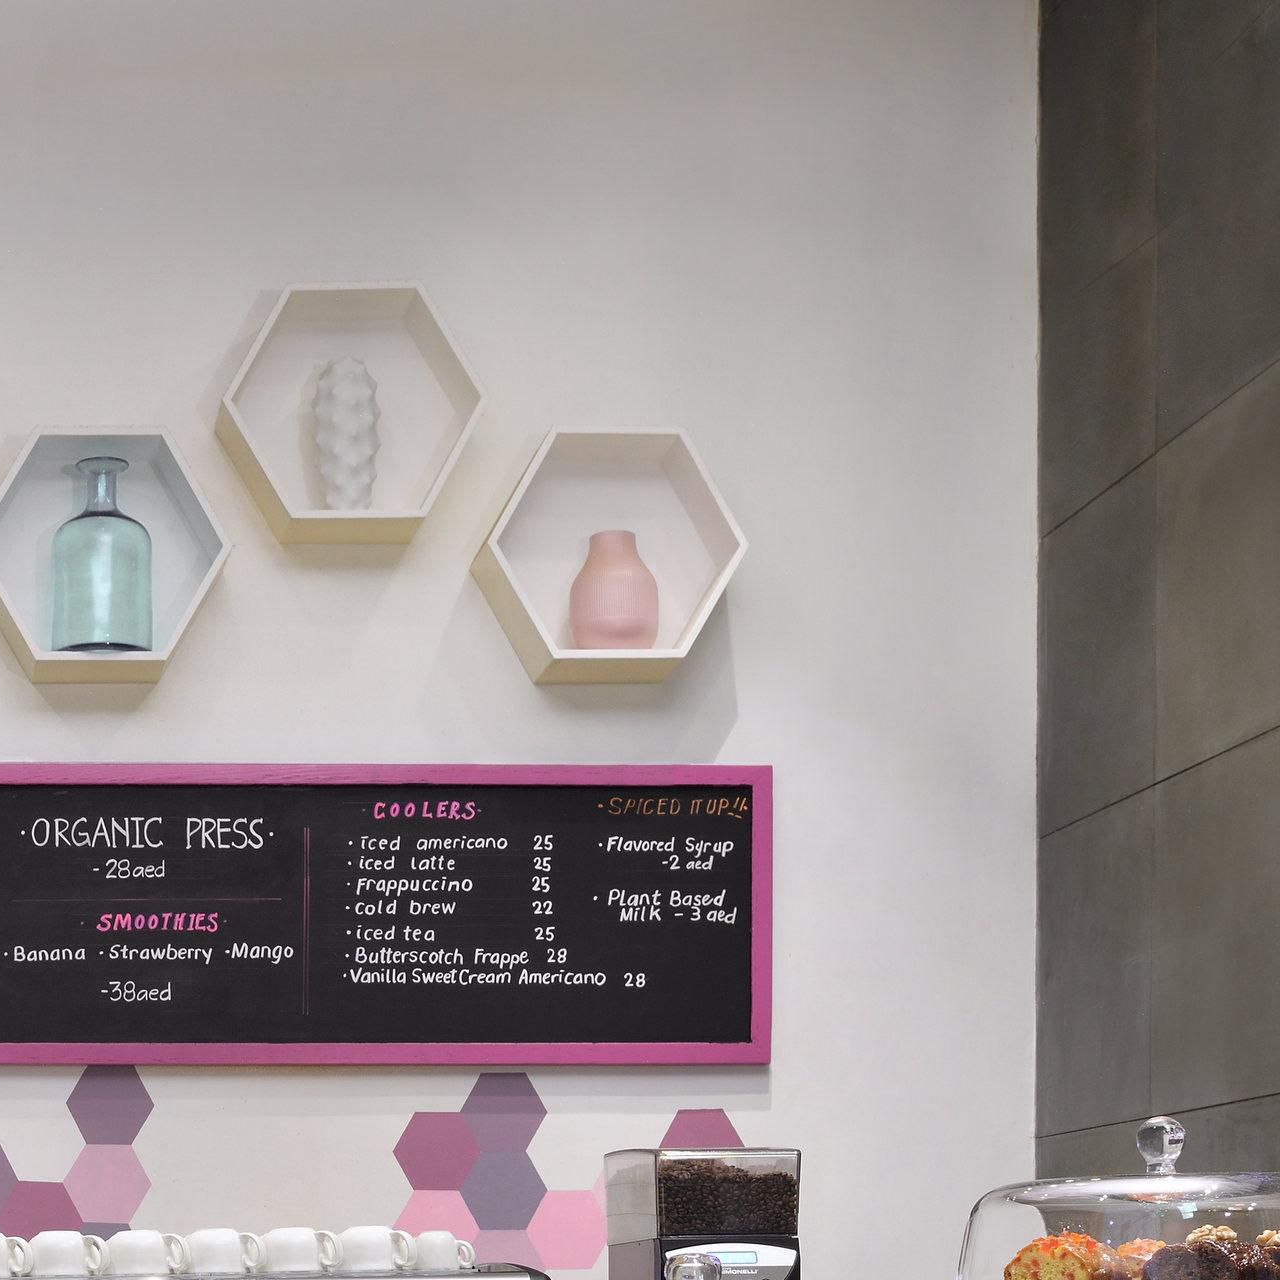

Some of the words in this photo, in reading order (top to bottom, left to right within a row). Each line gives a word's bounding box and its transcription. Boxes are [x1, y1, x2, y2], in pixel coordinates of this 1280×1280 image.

[374, 801, 475, 820] COOLERS
[609, 798, 680, 814] SPICED
[32, 817, 163, 848] ORGANIC
[186, 818, 263, 849] PRESS
[361, 836, 400, 851] iced
[417, 836, 507, 850] americano
[534, 835, 553, 850] 25
[607, 836, 675, 852] Flavored
[686, 837, 734, 858] Syrup
[359, 856, 395, 870] iced
[411, 855, 455, 870] latte
[534, 857, 551, 872] 25
[686, 855, 713, 870] aed
[532, 876, 550, 893] 25
[608, 889, 661, 906] Plant
[670, 889, 726, 907] Based
[410, 900, 456, 915] brew
[532, 901, 553, 914] 22
[620, 905, 661, 922] Milk
[707, 907, 737, 924] aed
[96, 912, 218, 932] SMOOTHIES
[357, 925, 395, 941] iced
[403, 926, 434, 941] tea
[535, 927, 555, 941] 25
[14, 946, 85, 962] Banana
[109, 944, 212, 964] Strawberry
[231, 943, 293, 964] Mango
[355, 947, 463, 965] Butterscotch
[475, 948, 529, 969] Frappe
[547, 948, 567, 963] 28
[350, 967, 406, 984] Vanilla
[519, 969, 606, 986] Americano
[624, 973, 645, 987] 28
